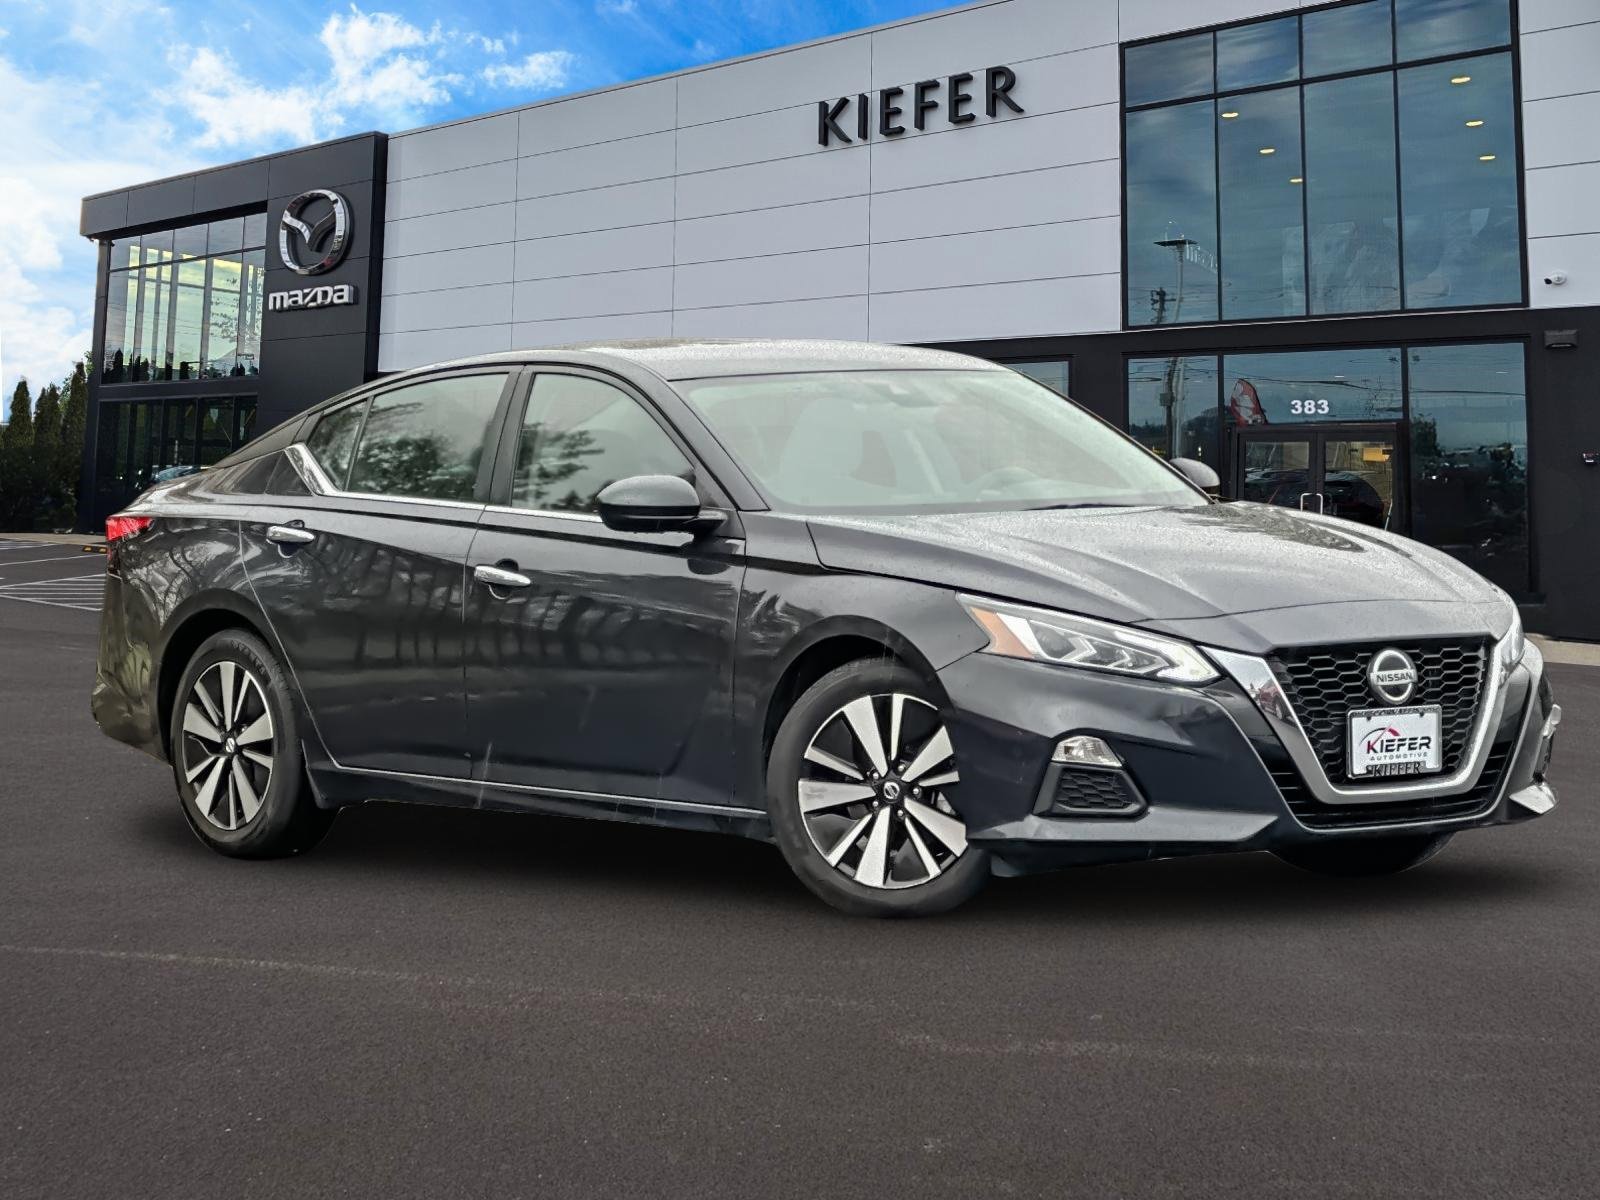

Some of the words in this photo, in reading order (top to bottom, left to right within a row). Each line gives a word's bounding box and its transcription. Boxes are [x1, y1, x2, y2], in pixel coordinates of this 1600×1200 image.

[818, 65, 1024, 146] KIEFER
[268, 284, 354, 311] mazda
[1290, 399, 1330, 415] 383
[1376, 671, 1414, 683] NISSAN
[1366, 735, 1432, 755] KIEFER
[1370, 751, 1428, 761] AUTOMOTIVE
[1373, 761, 1421, 777] KIEFER
